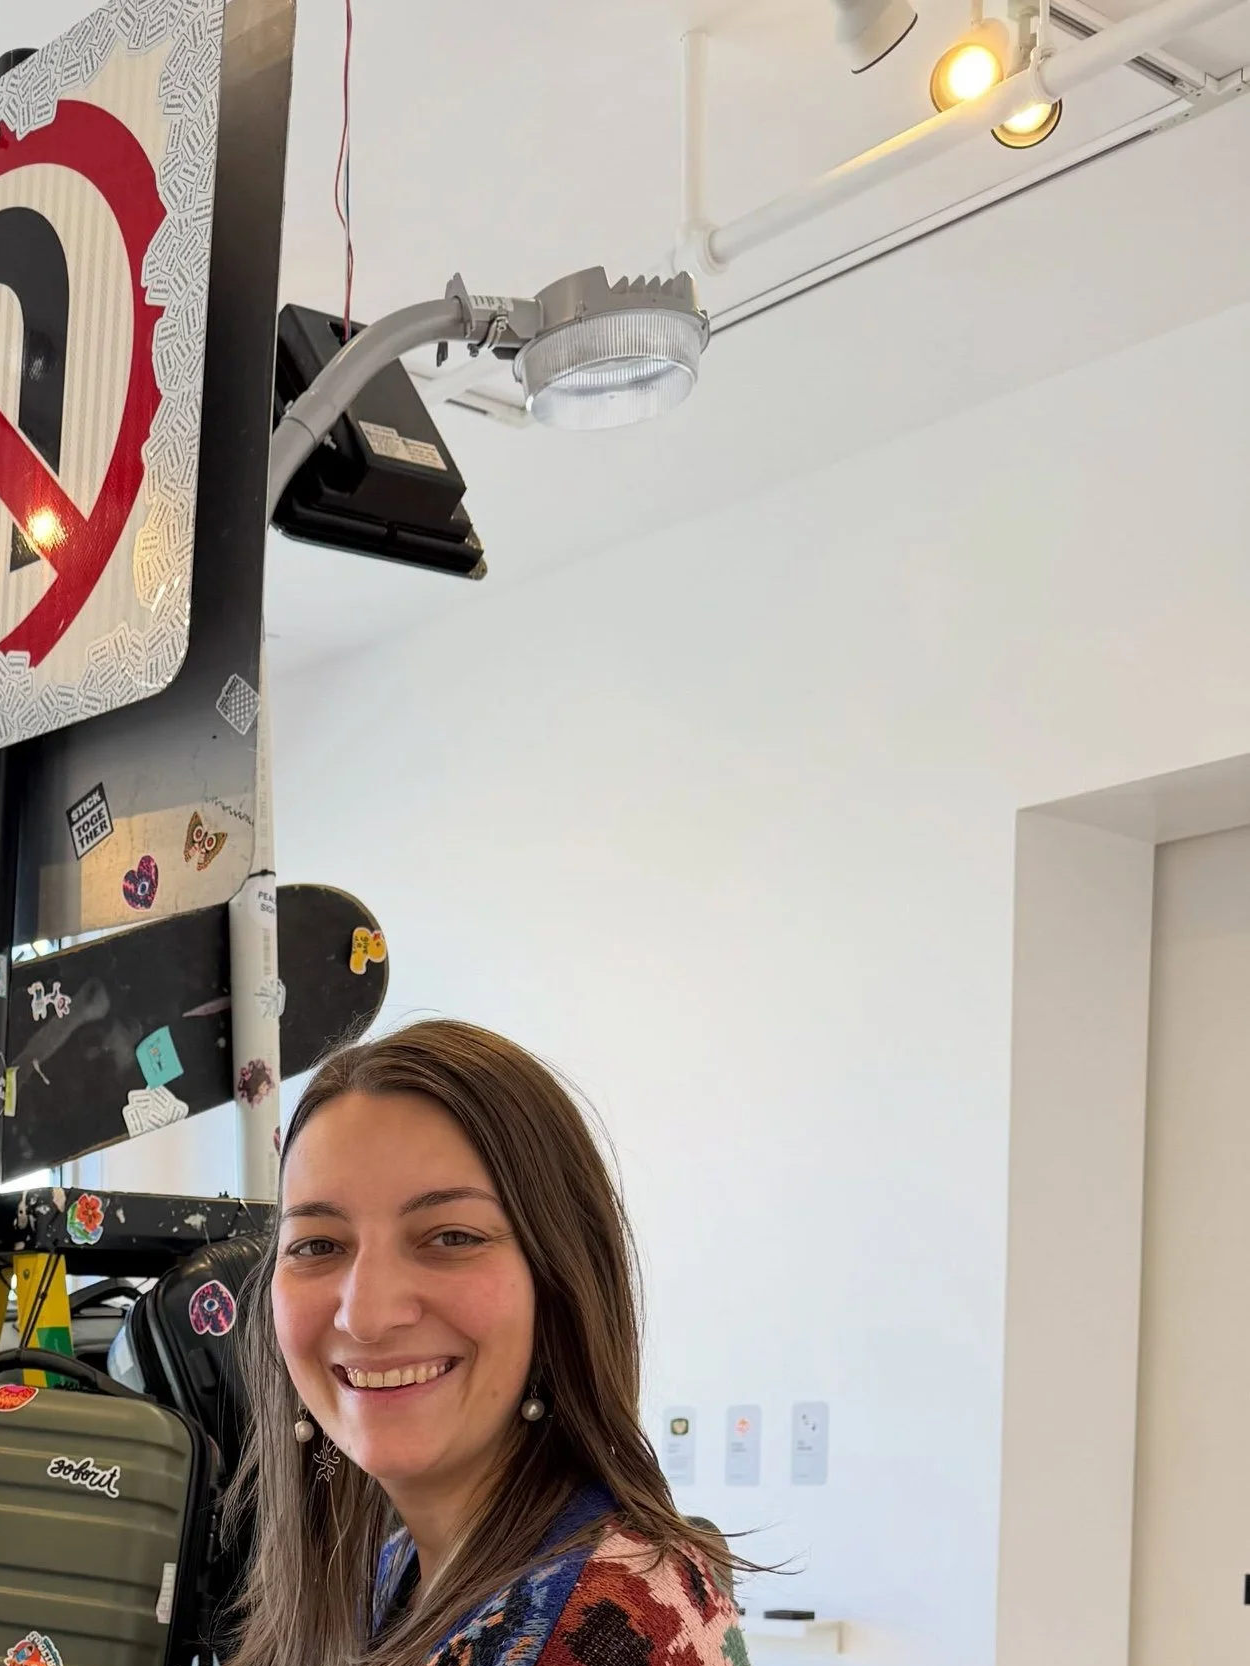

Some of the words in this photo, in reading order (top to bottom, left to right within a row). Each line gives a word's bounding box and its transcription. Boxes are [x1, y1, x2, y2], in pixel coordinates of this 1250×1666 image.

[71, 789, 102, 821] STICK
[75, 807, 106, 837] TOGE
[78, 820, 108, 848] THER
